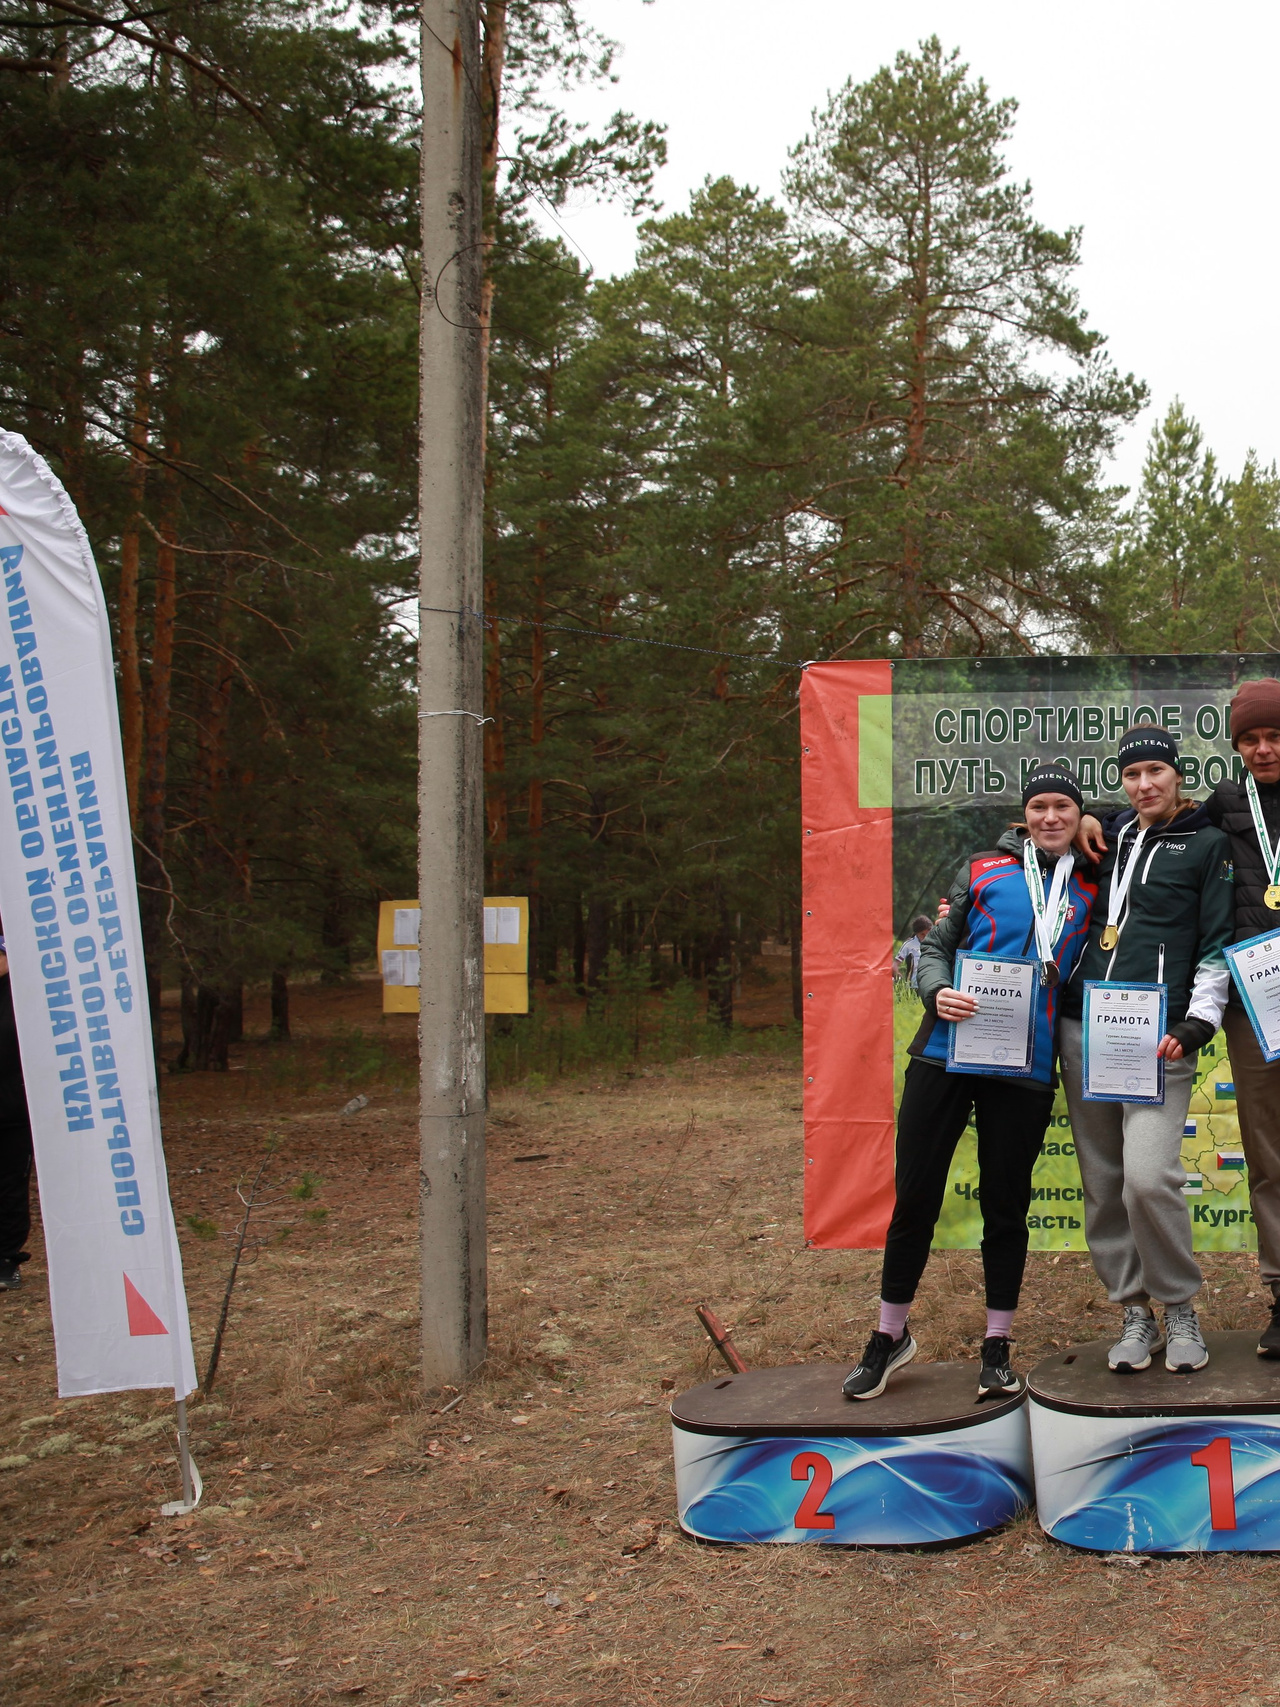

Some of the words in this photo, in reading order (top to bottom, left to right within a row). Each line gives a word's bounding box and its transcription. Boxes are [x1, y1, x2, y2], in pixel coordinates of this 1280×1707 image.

[933, 705, 1182, 744] СПОРТИВНОЕ
[914, 757, 1006, 795] ПУТЬ
[967, 985, 1023, 998] ГРАМОТА
[1097, 1015, 1151, 1026] ГРАМОТА
[790, 1451, 836, 1529] 2
[1190, 1436, 1237, 1530] 1
